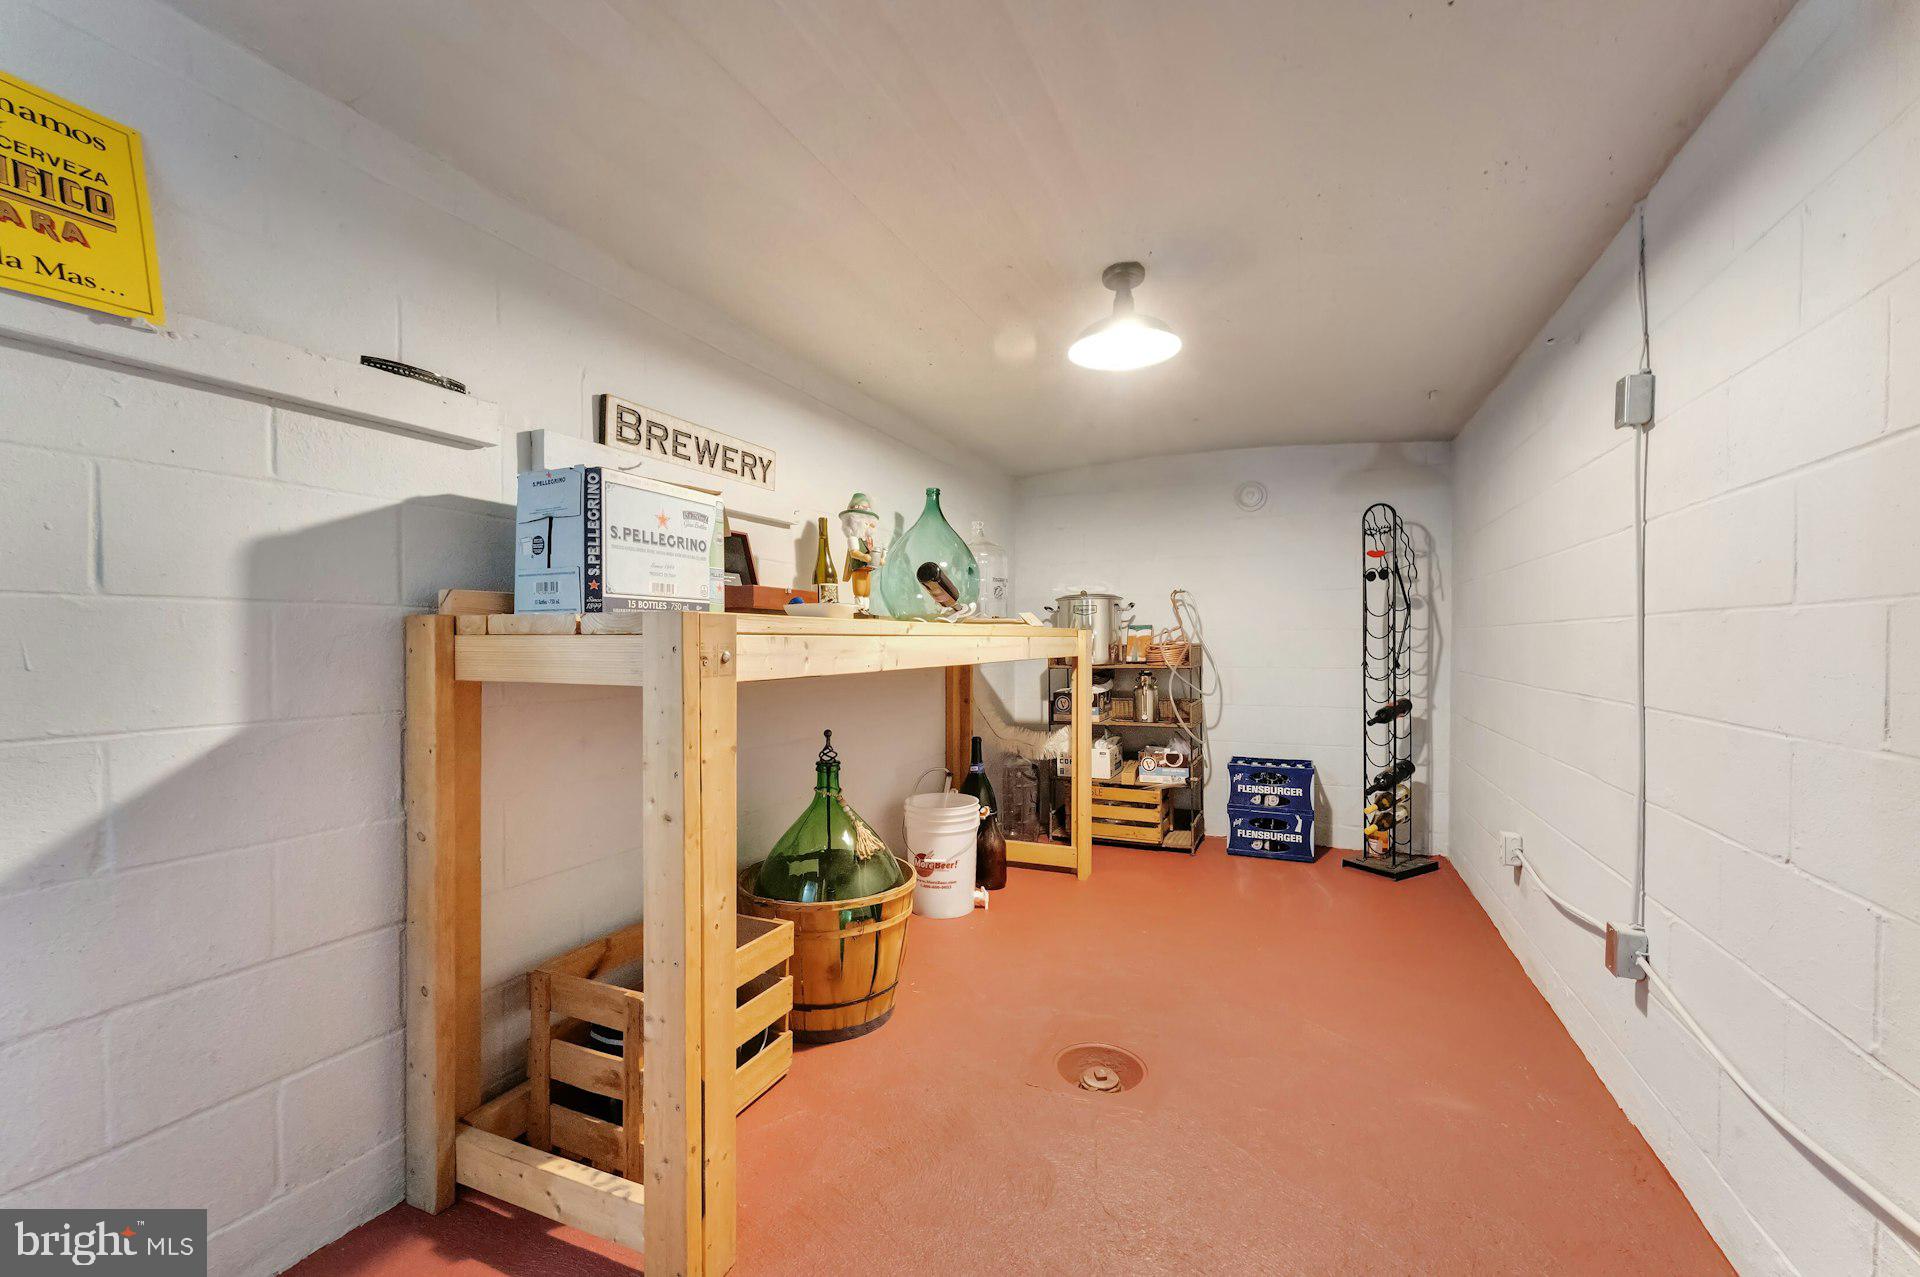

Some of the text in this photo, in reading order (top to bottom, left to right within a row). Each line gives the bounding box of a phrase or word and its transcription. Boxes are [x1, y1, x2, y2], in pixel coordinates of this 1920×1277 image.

[0, 135, 108, 186] CERVEZA
[616, 404, 772, 484] BREWERY
[532, 476, 566, 488] S.PELLEGRINO
[587, 472, 600, 576] S.PELLEGRINO
[610, 525, 707, 552] S.PELLEGRINO
[627, 600, 637, 608] 15
[638, 601, 667, 610] BOTTLES
[670, 602, 682, 611] 750
[1237, 784, 1303, 797] FLENSBURGER
[1237, 829, 1303, 843] FLENSBURGER
